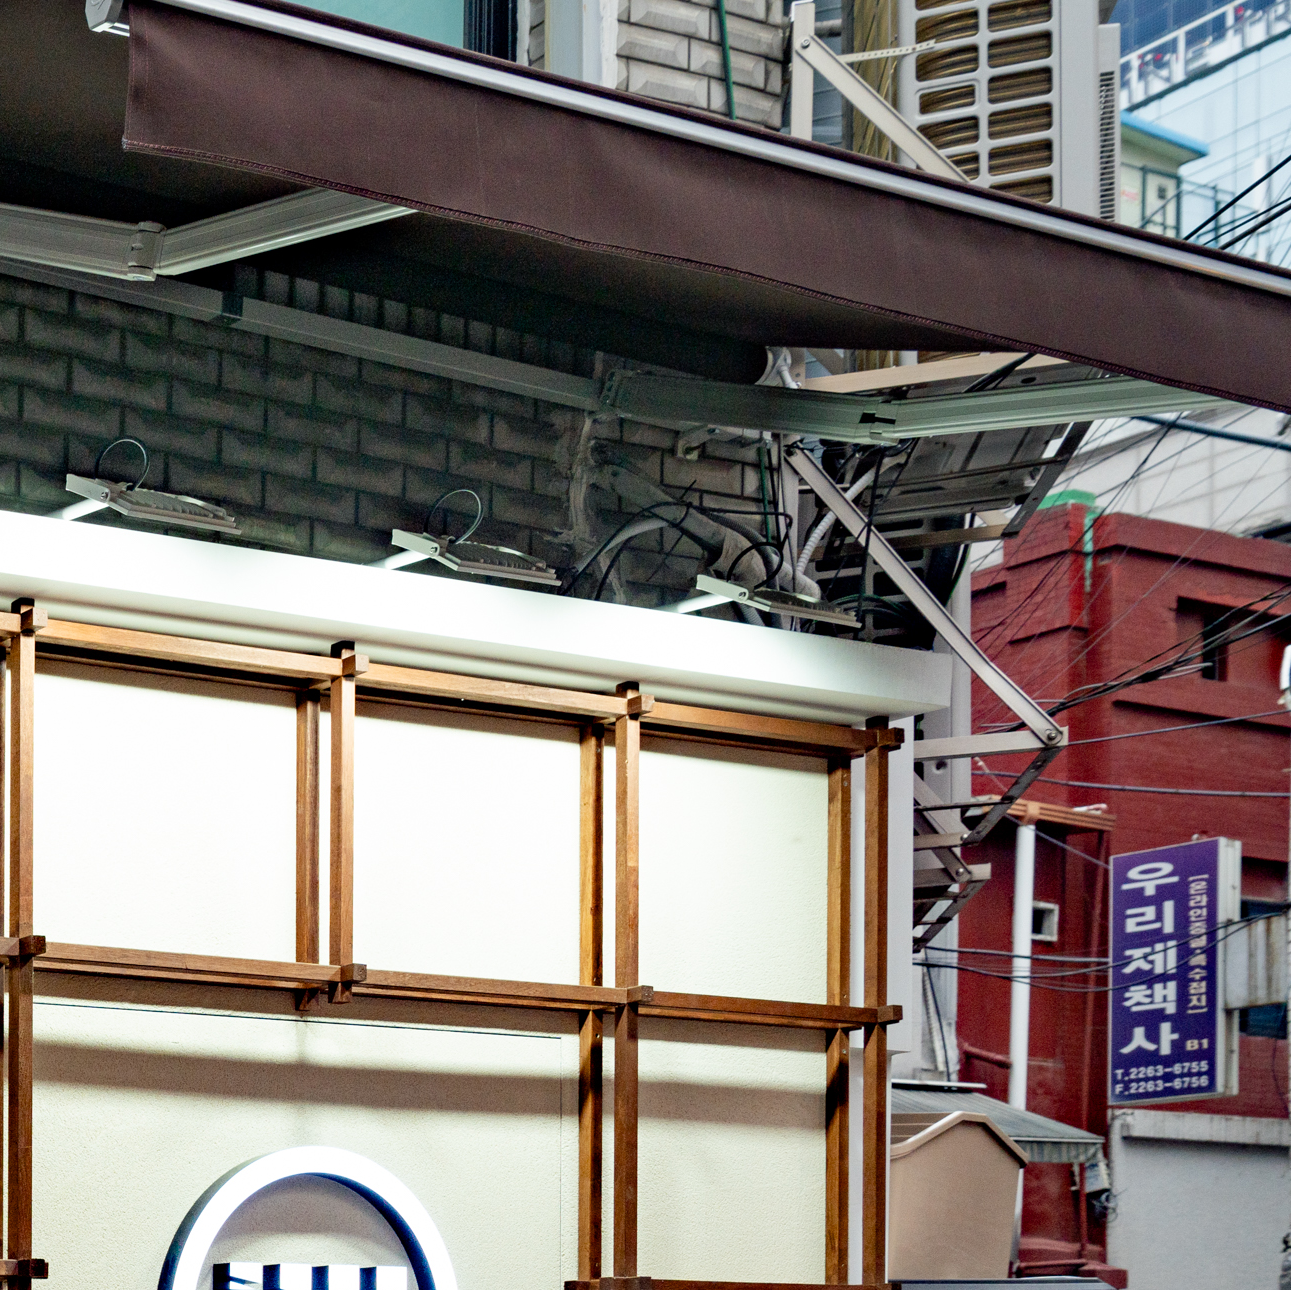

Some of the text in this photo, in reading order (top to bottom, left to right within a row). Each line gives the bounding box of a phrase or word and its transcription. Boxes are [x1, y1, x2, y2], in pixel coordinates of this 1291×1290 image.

[1119, 861, 1180, 1056] 우리제책사
[1185, 1038, 1209, 1051] B1
[1114, 1060, 1209, 1081] T.2263-6755
[1115, 1075, 1209, 1095] F.2263-6756
